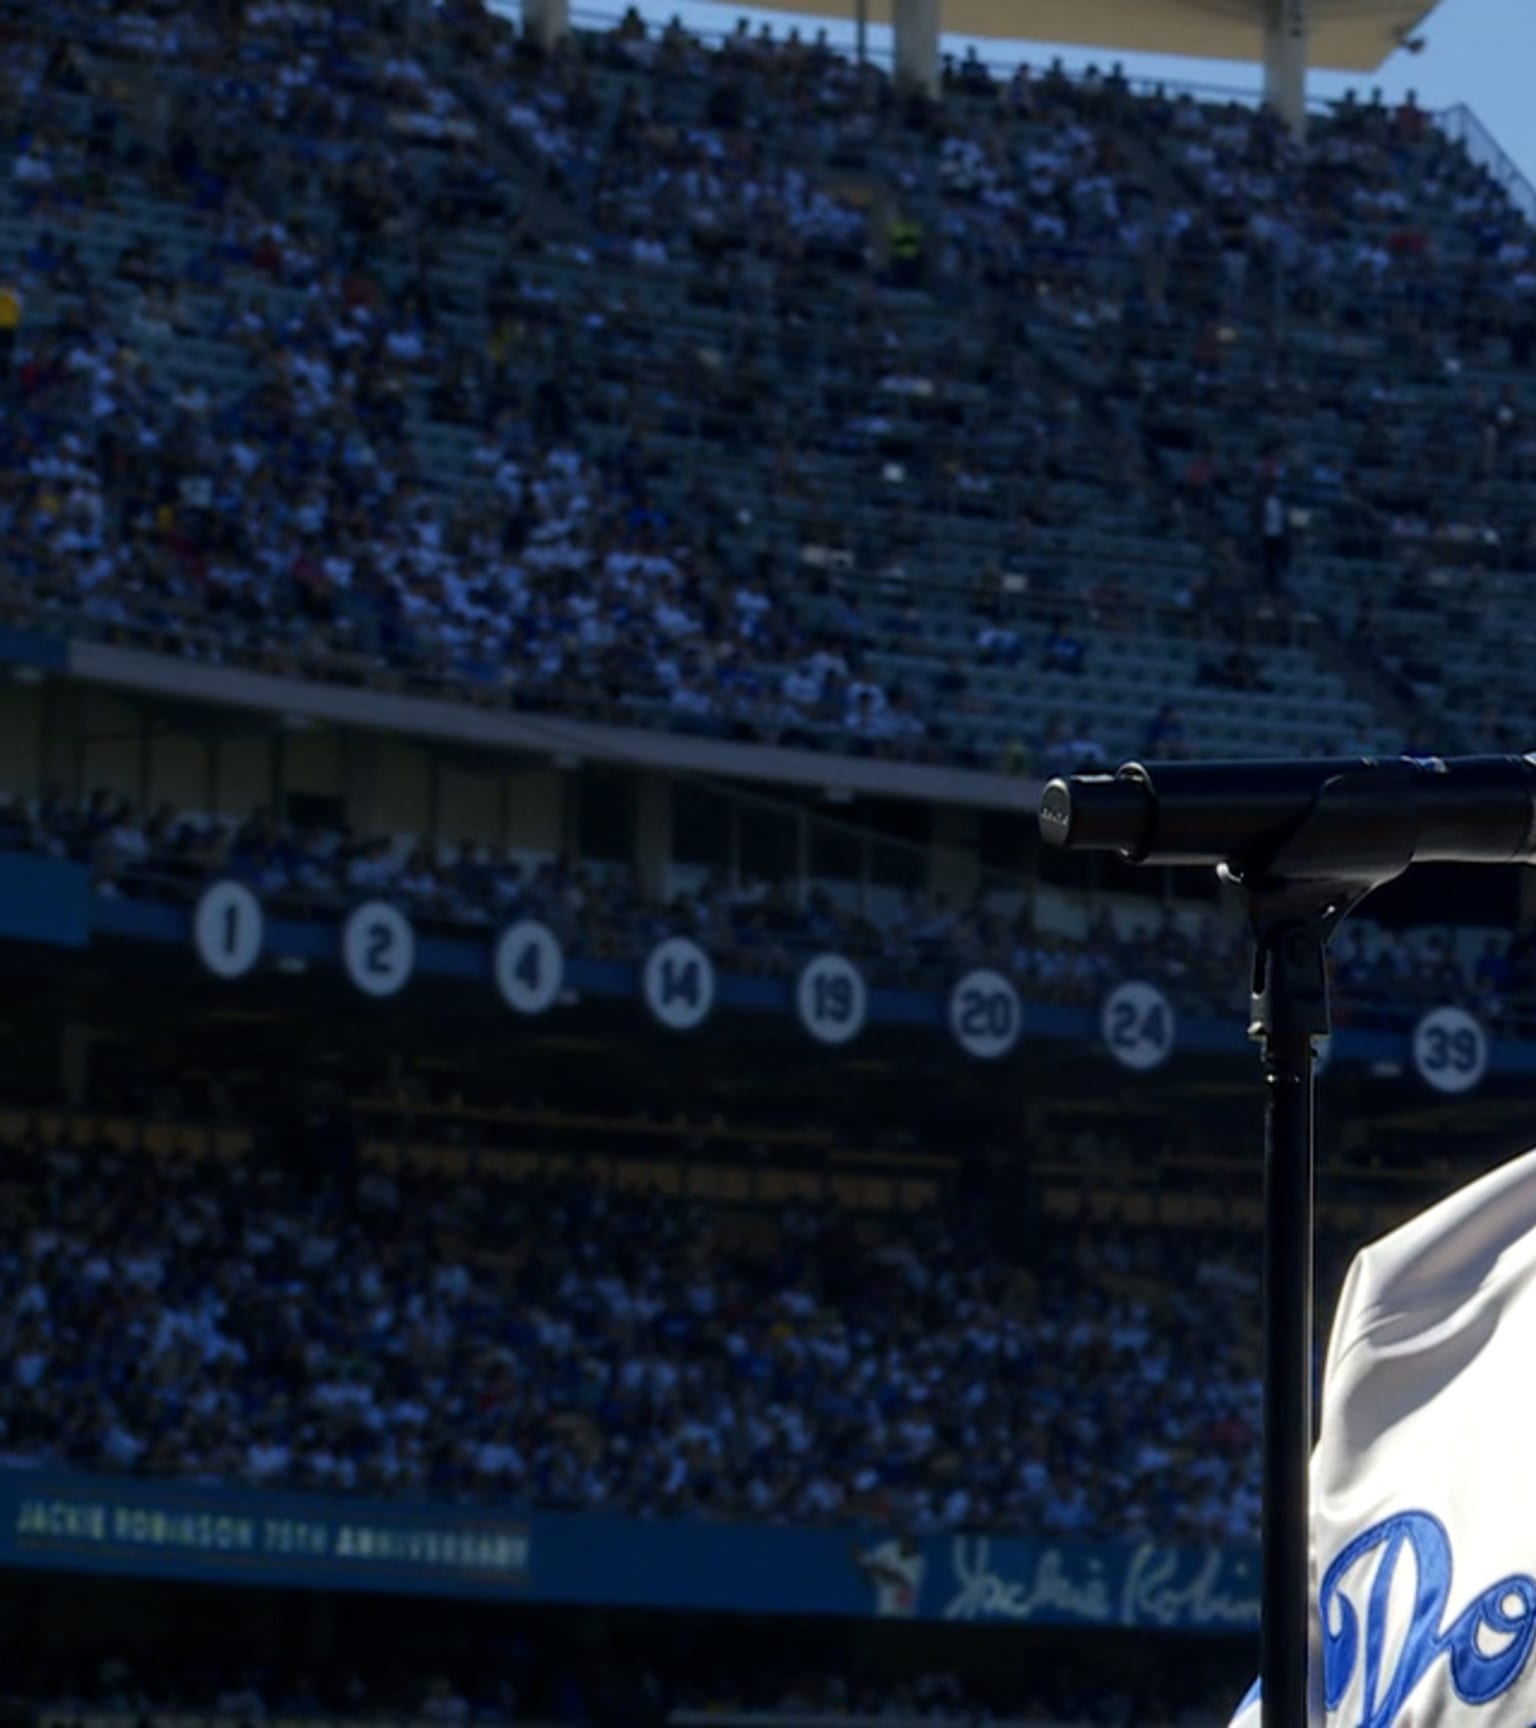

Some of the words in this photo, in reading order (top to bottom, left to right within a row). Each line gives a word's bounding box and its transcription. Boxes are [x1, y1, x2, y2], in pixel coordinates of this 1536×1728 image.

[222, 905, 238, 954] 1
[367, 925, 394, 974] 2
[514, 943, 542, 990] 4
[658, 958, 700, 1007] 14
[811, 973, 853, 1023] 19
[960, 992, 1011, 1039] 20
[1112, 1002, 1164, 1049] 24
[1424, 1028, 1476, 1073] 39
[16, 1500, 104, 1541] JACKIE
[114, 1508, 255, 1549] ROBINSON
[1119, 1540, 1262, 1624] Robin
